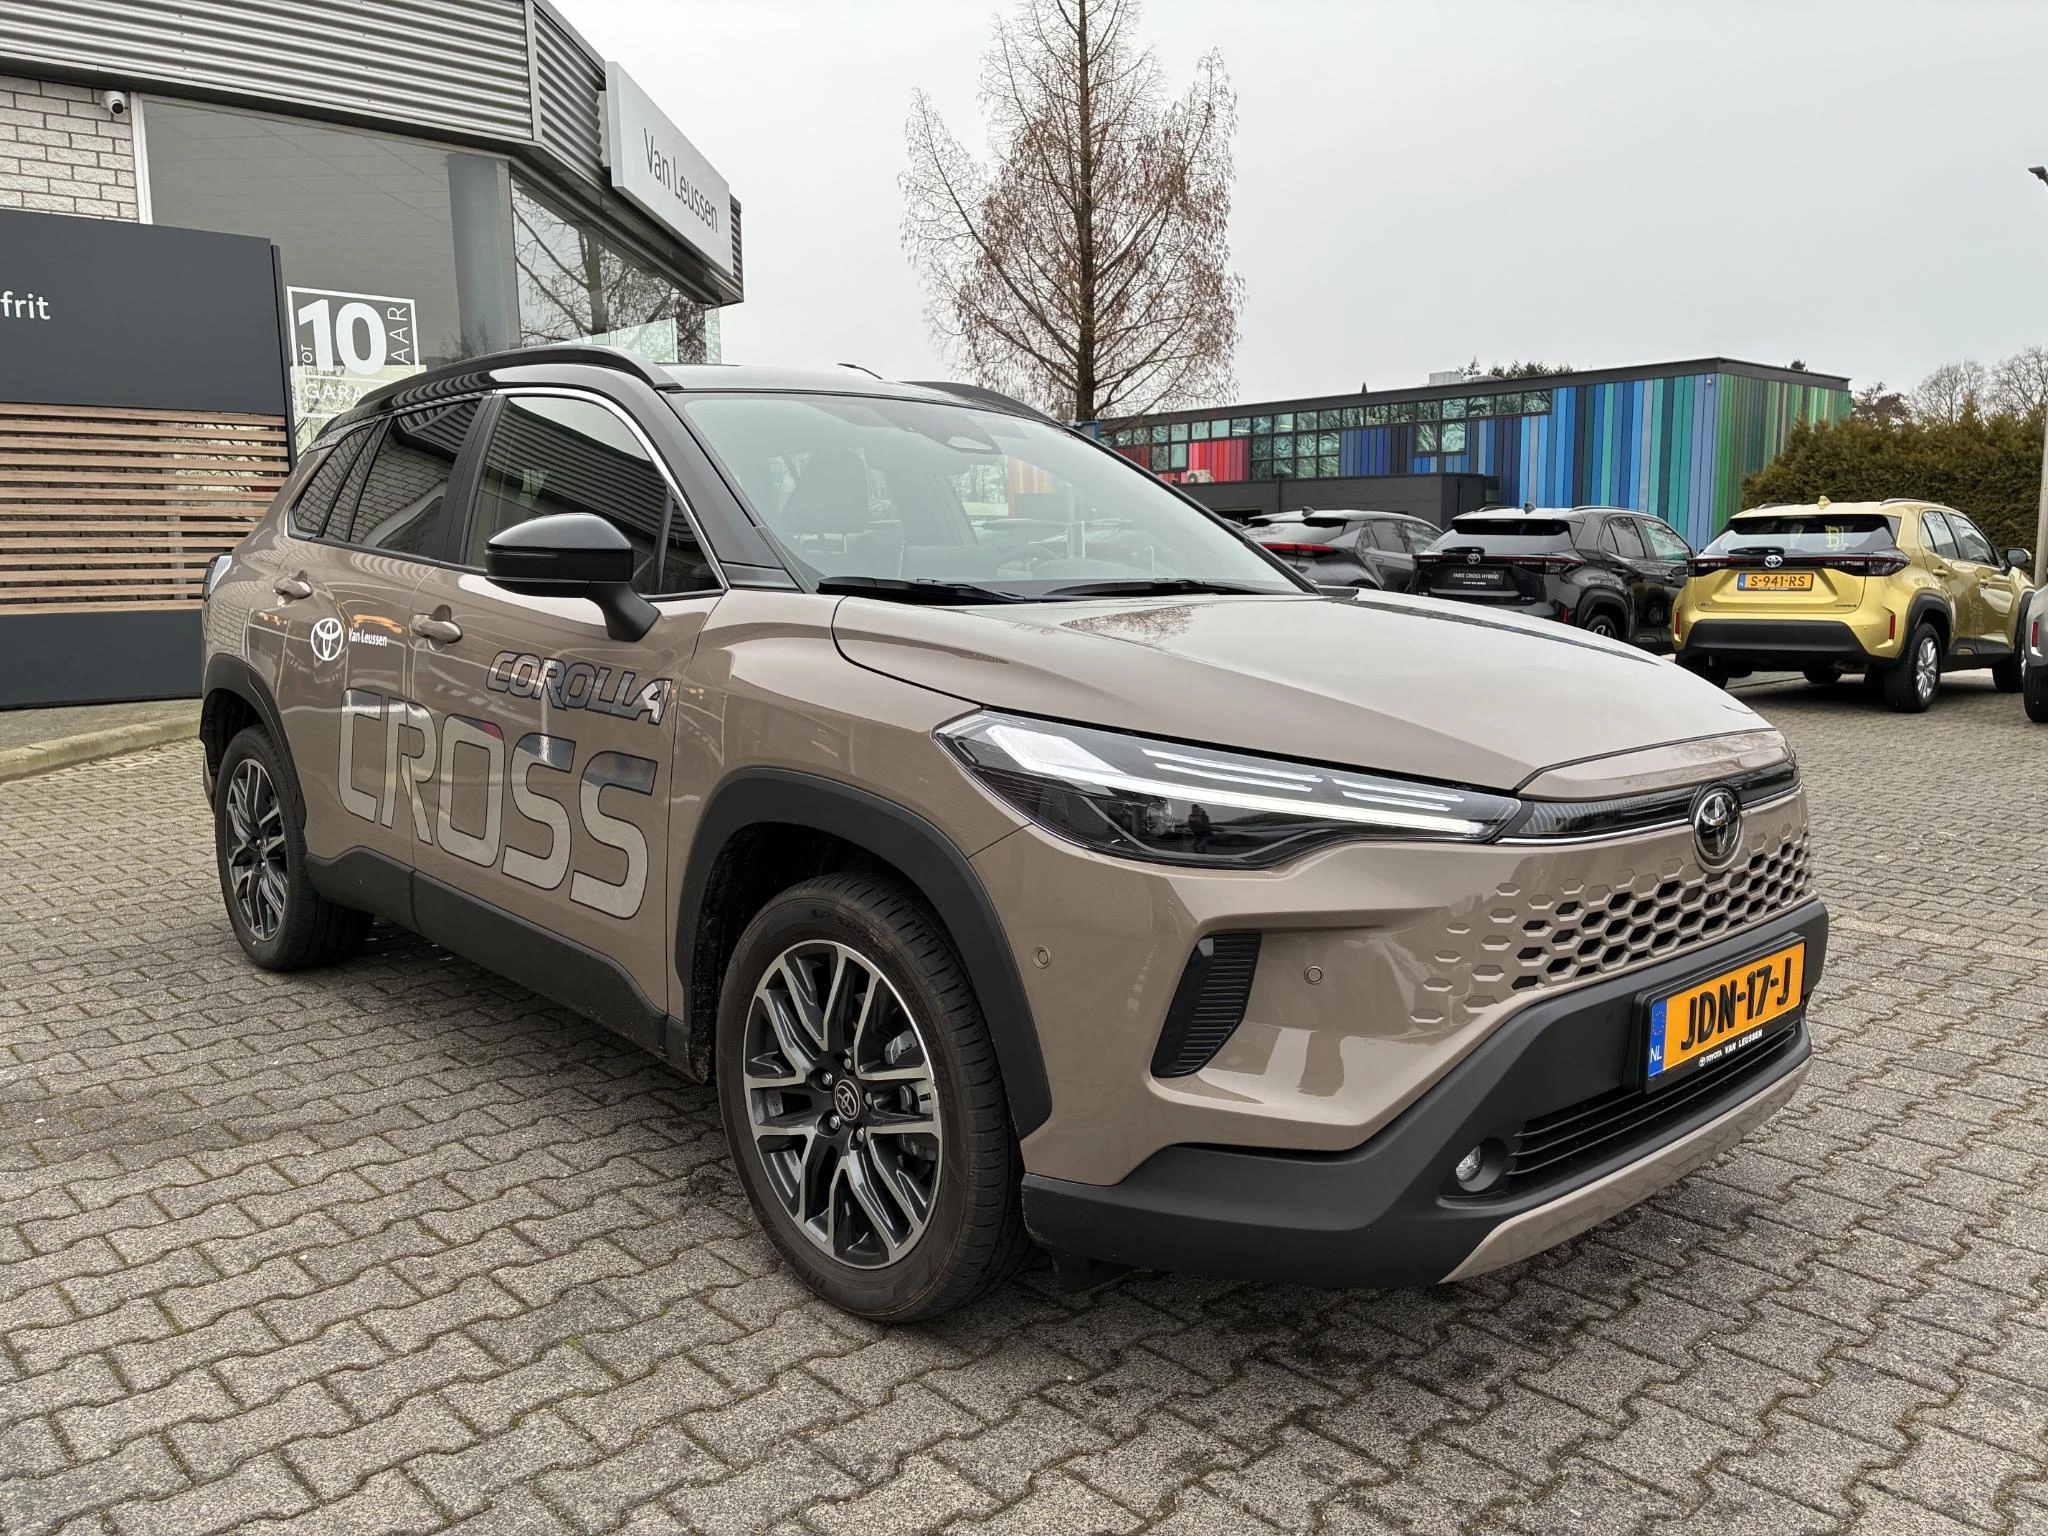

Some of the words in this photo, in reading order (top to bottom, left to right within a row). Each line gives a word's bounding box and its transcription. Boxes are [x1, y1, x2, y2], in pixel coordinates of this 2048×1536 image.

[643, 127, 671, 190] Van
[673, 156, 718, 233] Leussen
[298, 298, 387, 375] 10
[305, 383, 372, 401] GARA
[1750, 575, 1806, 587] S-941-RS
[348, 627, 360, 643] Van
[361, 629, 388, 647] Leussen
[486, 650, 674, 727] COROLLA
[338, 687, 658, 920] CROSS
[1681, 956, 1792, 1051] JDN-17-J
[1650, 1044, 1663, 1063] NL
[1705, 1049, 1723, 1063] TOYOTA
[1724, 1041, 1737, 1055] VAN
[1738, 1028, 1763, 1048] LEUSSEN
